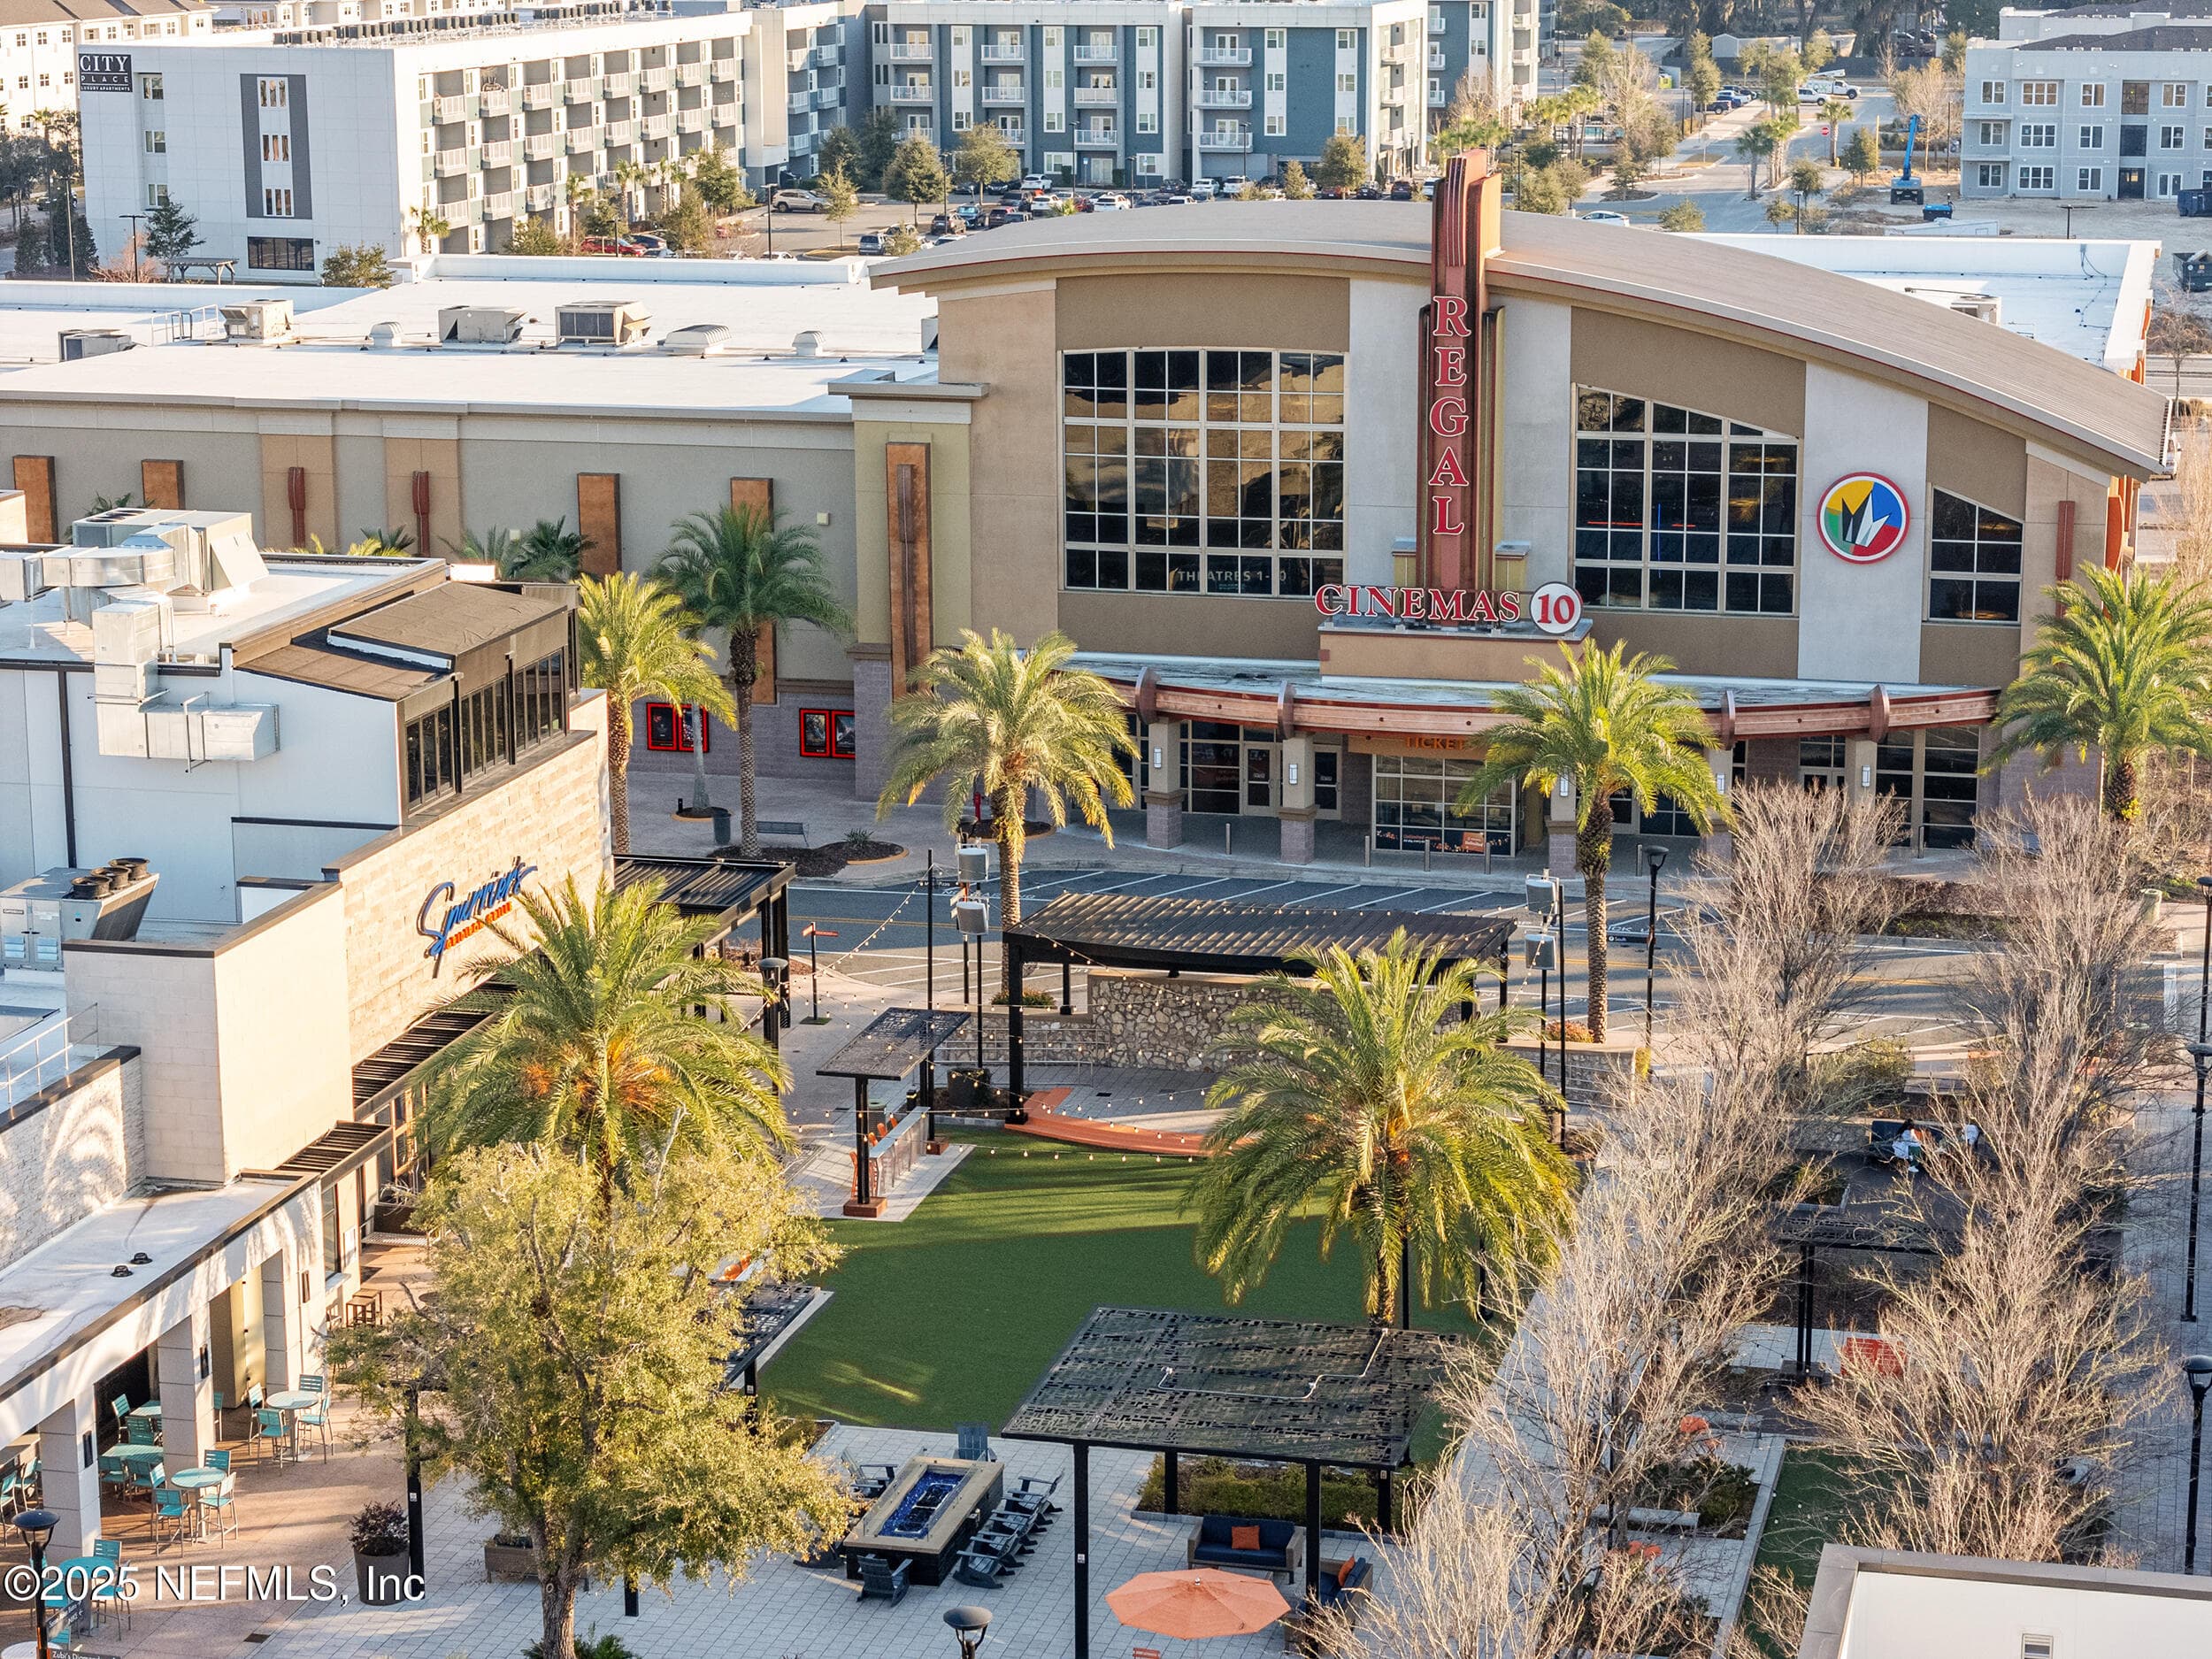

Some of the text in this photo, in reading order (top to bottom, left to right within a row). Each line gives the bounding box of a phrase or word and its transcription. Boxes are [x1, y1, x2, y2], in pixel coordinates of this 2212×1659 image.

[80, 55, 128, 72] CITY
[1429, 296, 1471, 535] REGAL
[1315, 584, 1575, 625] CINEMAS 10
